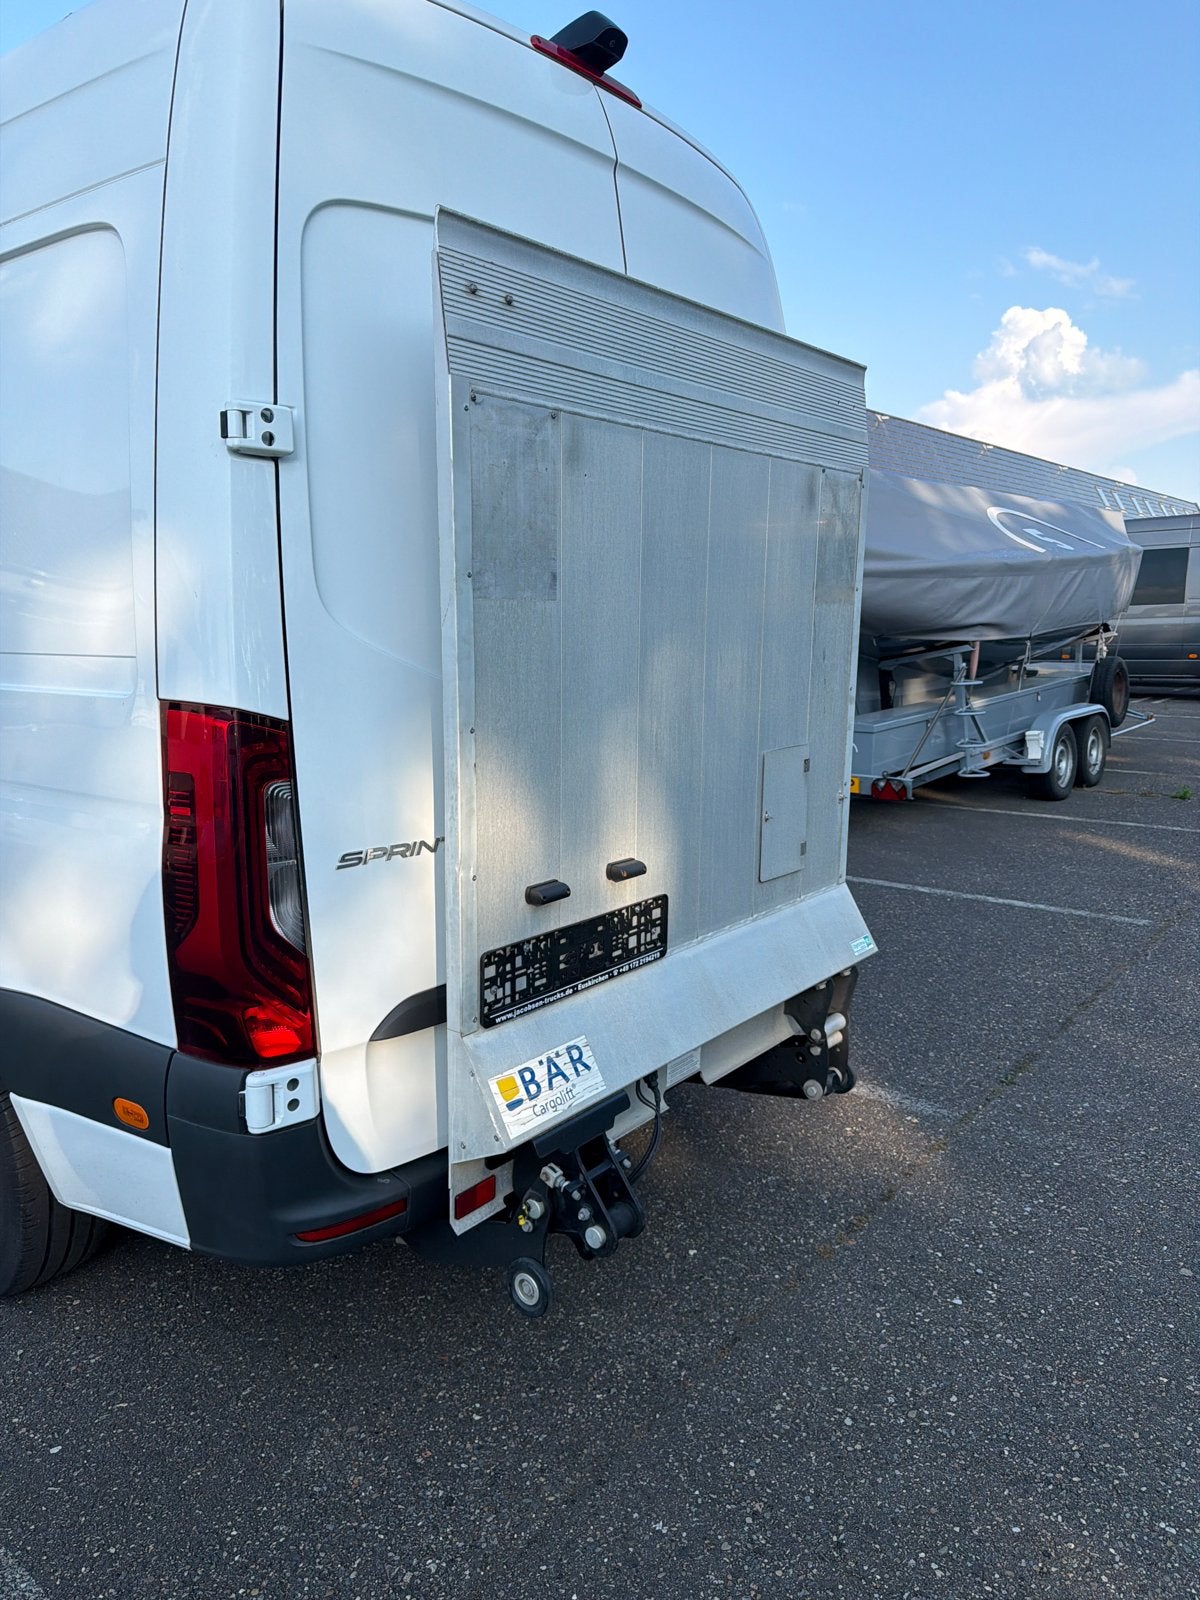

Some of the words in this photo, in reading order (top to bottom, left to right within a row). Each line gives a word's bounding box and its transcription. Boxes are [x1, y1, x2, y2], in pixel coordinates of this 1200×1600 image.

[335, 836, 445, 871] SPRIN
[495, 988, 574, 1023] www.jacobsen-trucks.de
[577, 974, 609, 991] Euskirchen
[619, 965, 630, 973] +49
[630, 961, 639, 970] 172
[518, 1044, 592, 1101] BÄR
